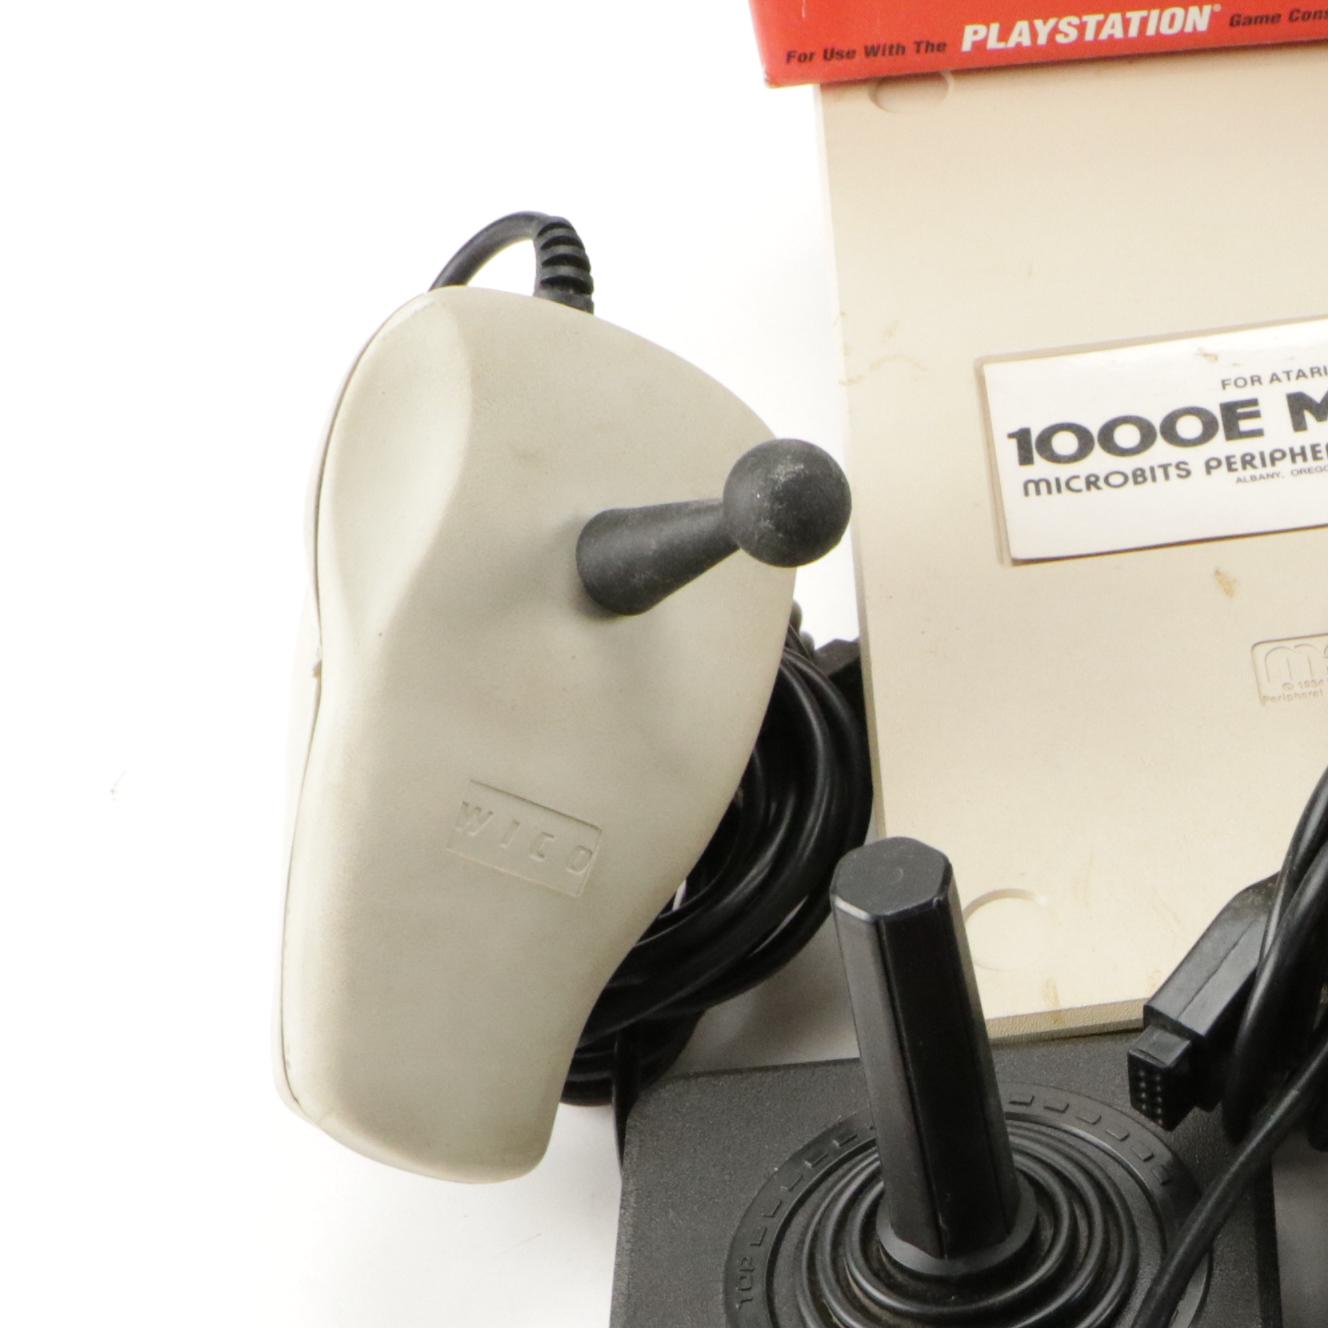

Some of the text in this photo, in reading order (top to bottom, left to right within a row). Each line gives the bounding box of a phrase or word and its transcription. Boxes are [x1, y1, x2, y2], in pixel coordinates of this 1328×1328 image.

[785, 50, 815, 64] For
[823, 48, 856, 62] Use
[863, 44, 906, 58] With
[914, 40, 947, 54] The
[1229, 13, 1282, 28] Game
[1220, 365, 1328, 391] FOR ATARI
[1007, 397, 1265, 467] 1000E
[455, 800, 594, 876] WICO
